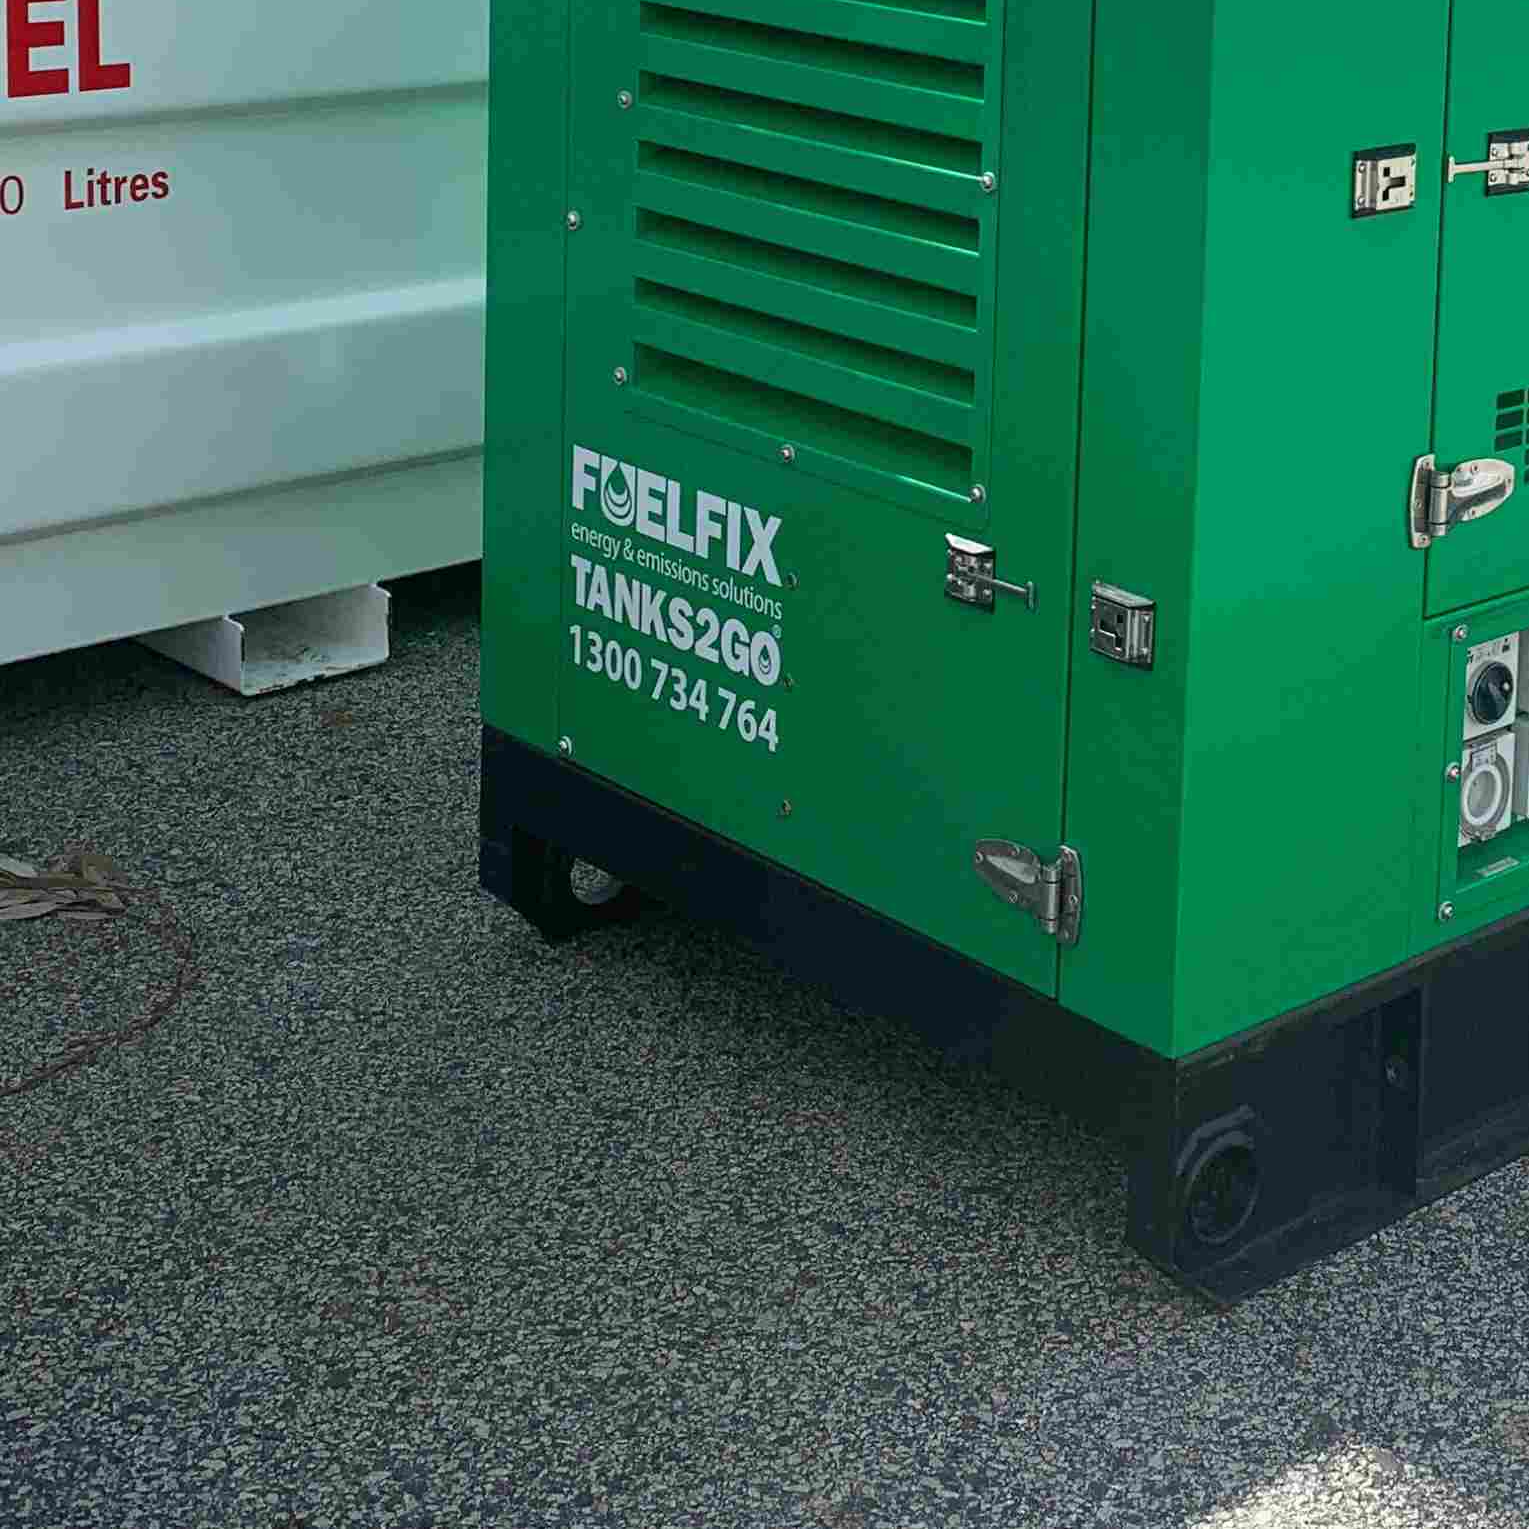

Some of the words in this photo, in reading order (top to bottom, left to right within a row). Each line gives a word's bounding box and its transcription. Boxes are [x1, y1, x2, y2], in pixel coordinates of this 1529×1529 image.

[64, 168, 169, 210] Litres
[571, 444, 782, 587] FUELFIX
[571, 523, 621, 562] energy
[623, 538, 635, 562] &
[637, 547, 709, 592] emissions
[712, 575, 783, 620] solutions
[569, 624, 642, 690] 1300
[651, 658, 709, 722] 734
[718, 687, 779, 752] 764
